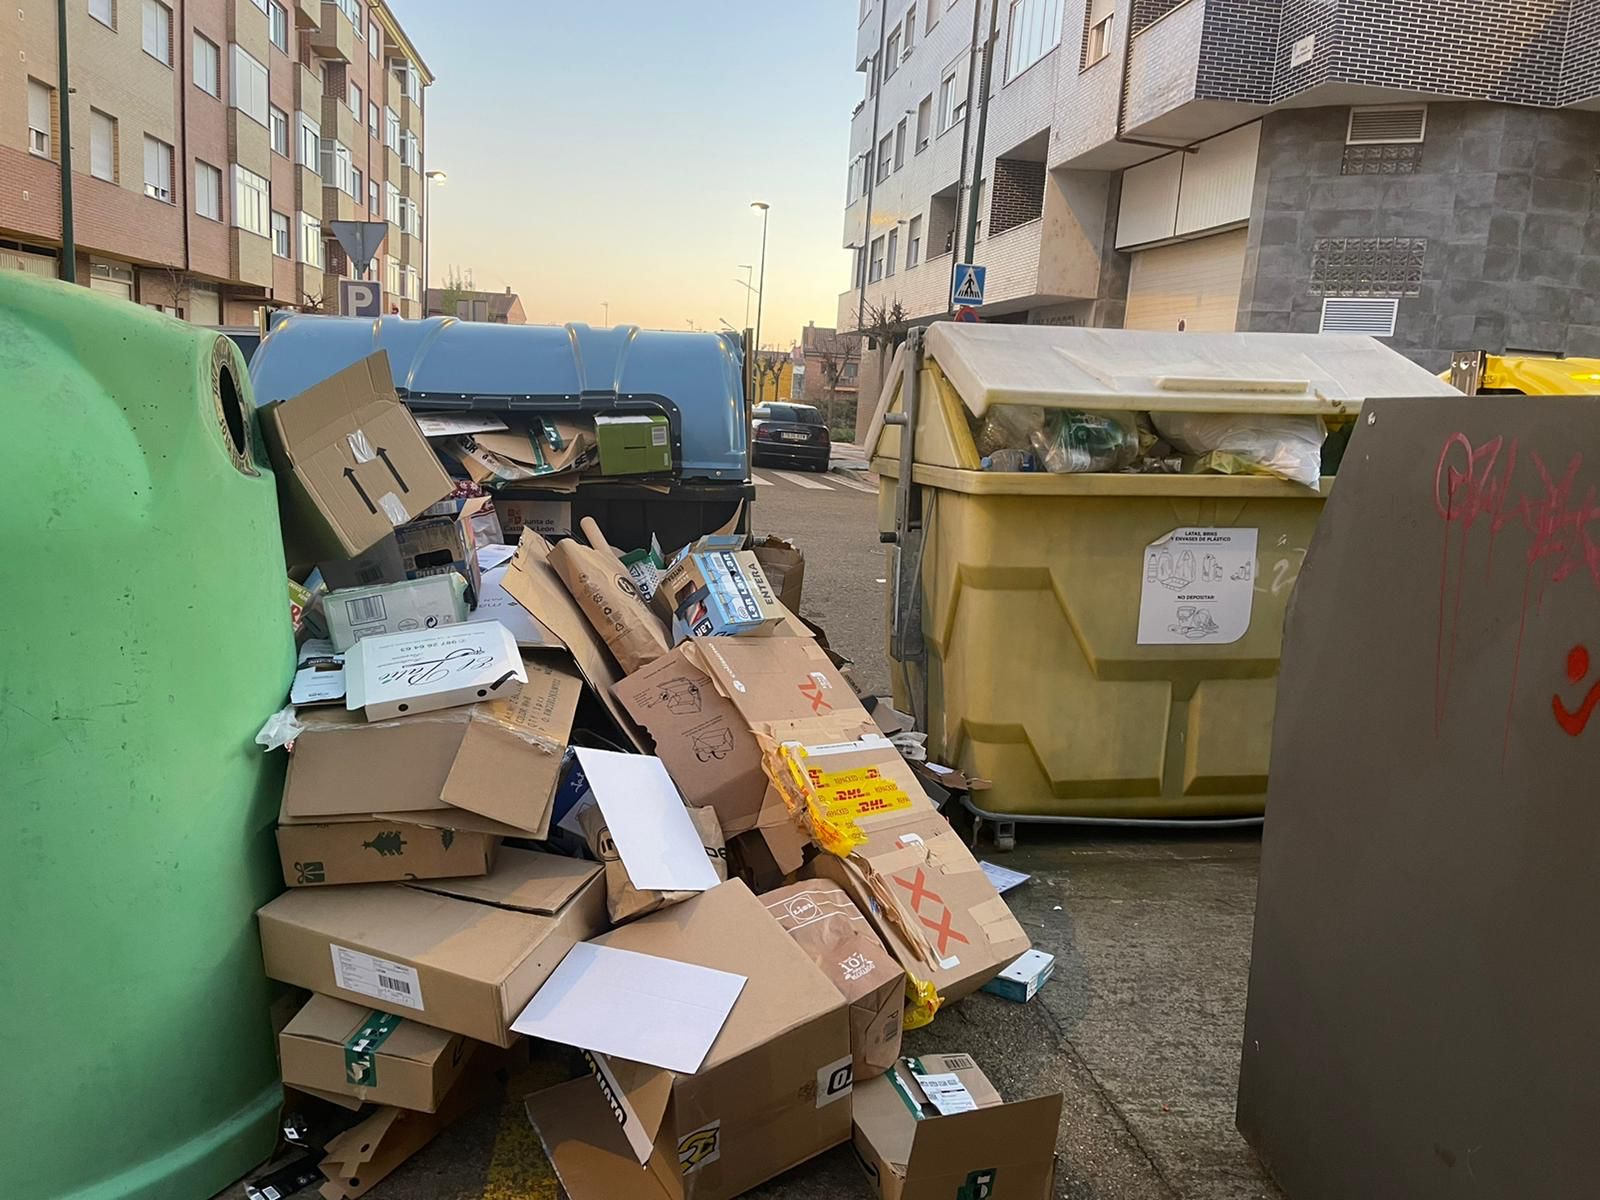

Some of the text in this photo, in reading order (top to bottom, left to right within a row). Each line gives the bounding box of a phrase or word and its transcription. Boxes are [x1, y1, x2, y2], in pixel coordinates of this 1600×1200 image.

[348, 286, 373, 317] P
[748, 562, 774, 606] ENTERA
[456, 656, 494, 672] El
[798, 675, 832, 715] XL
[836, 788, 865, 801] DHL
[858, 798, 888, 813] DHL
[891, 867, 970, 956] XX
